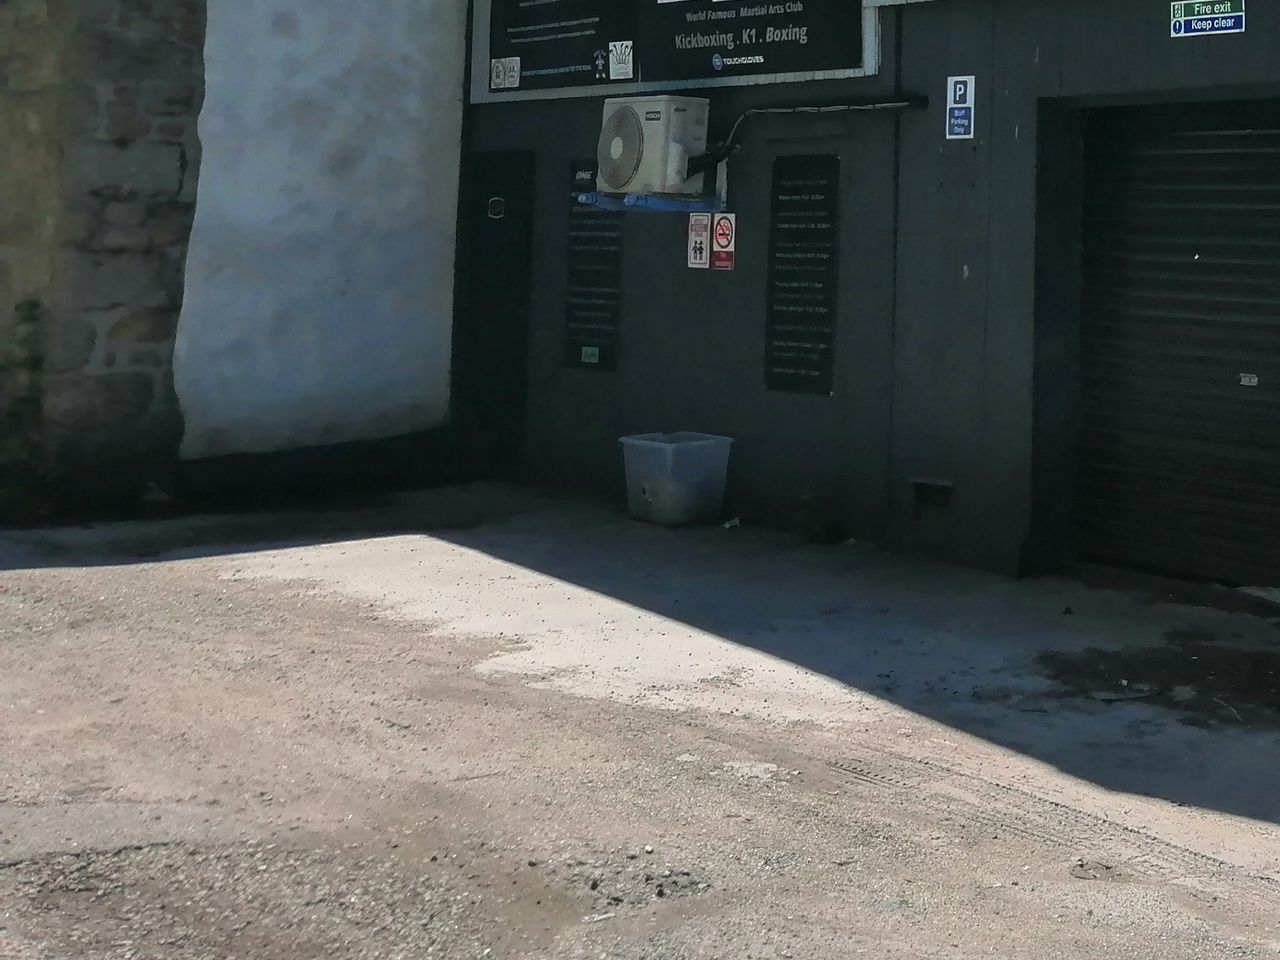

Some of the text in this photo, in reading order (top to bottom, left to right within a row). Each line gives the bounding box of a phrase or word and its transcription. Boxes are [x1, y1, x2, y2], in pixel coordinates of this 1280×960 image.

[686, 1, 803, 22] World Famous Martial Arts Club
[1194, 1, 1231, 15] Fire exit
[1191, 18, 1234, 30] Keep clear
[675, 30, 734, 50] Kickboxing
[742, 28, 756, 44] K1
[766, 24, 808, 44] Boxing
[956, 84, 964, 100] P
[575, 170, 593, 180] ONE
